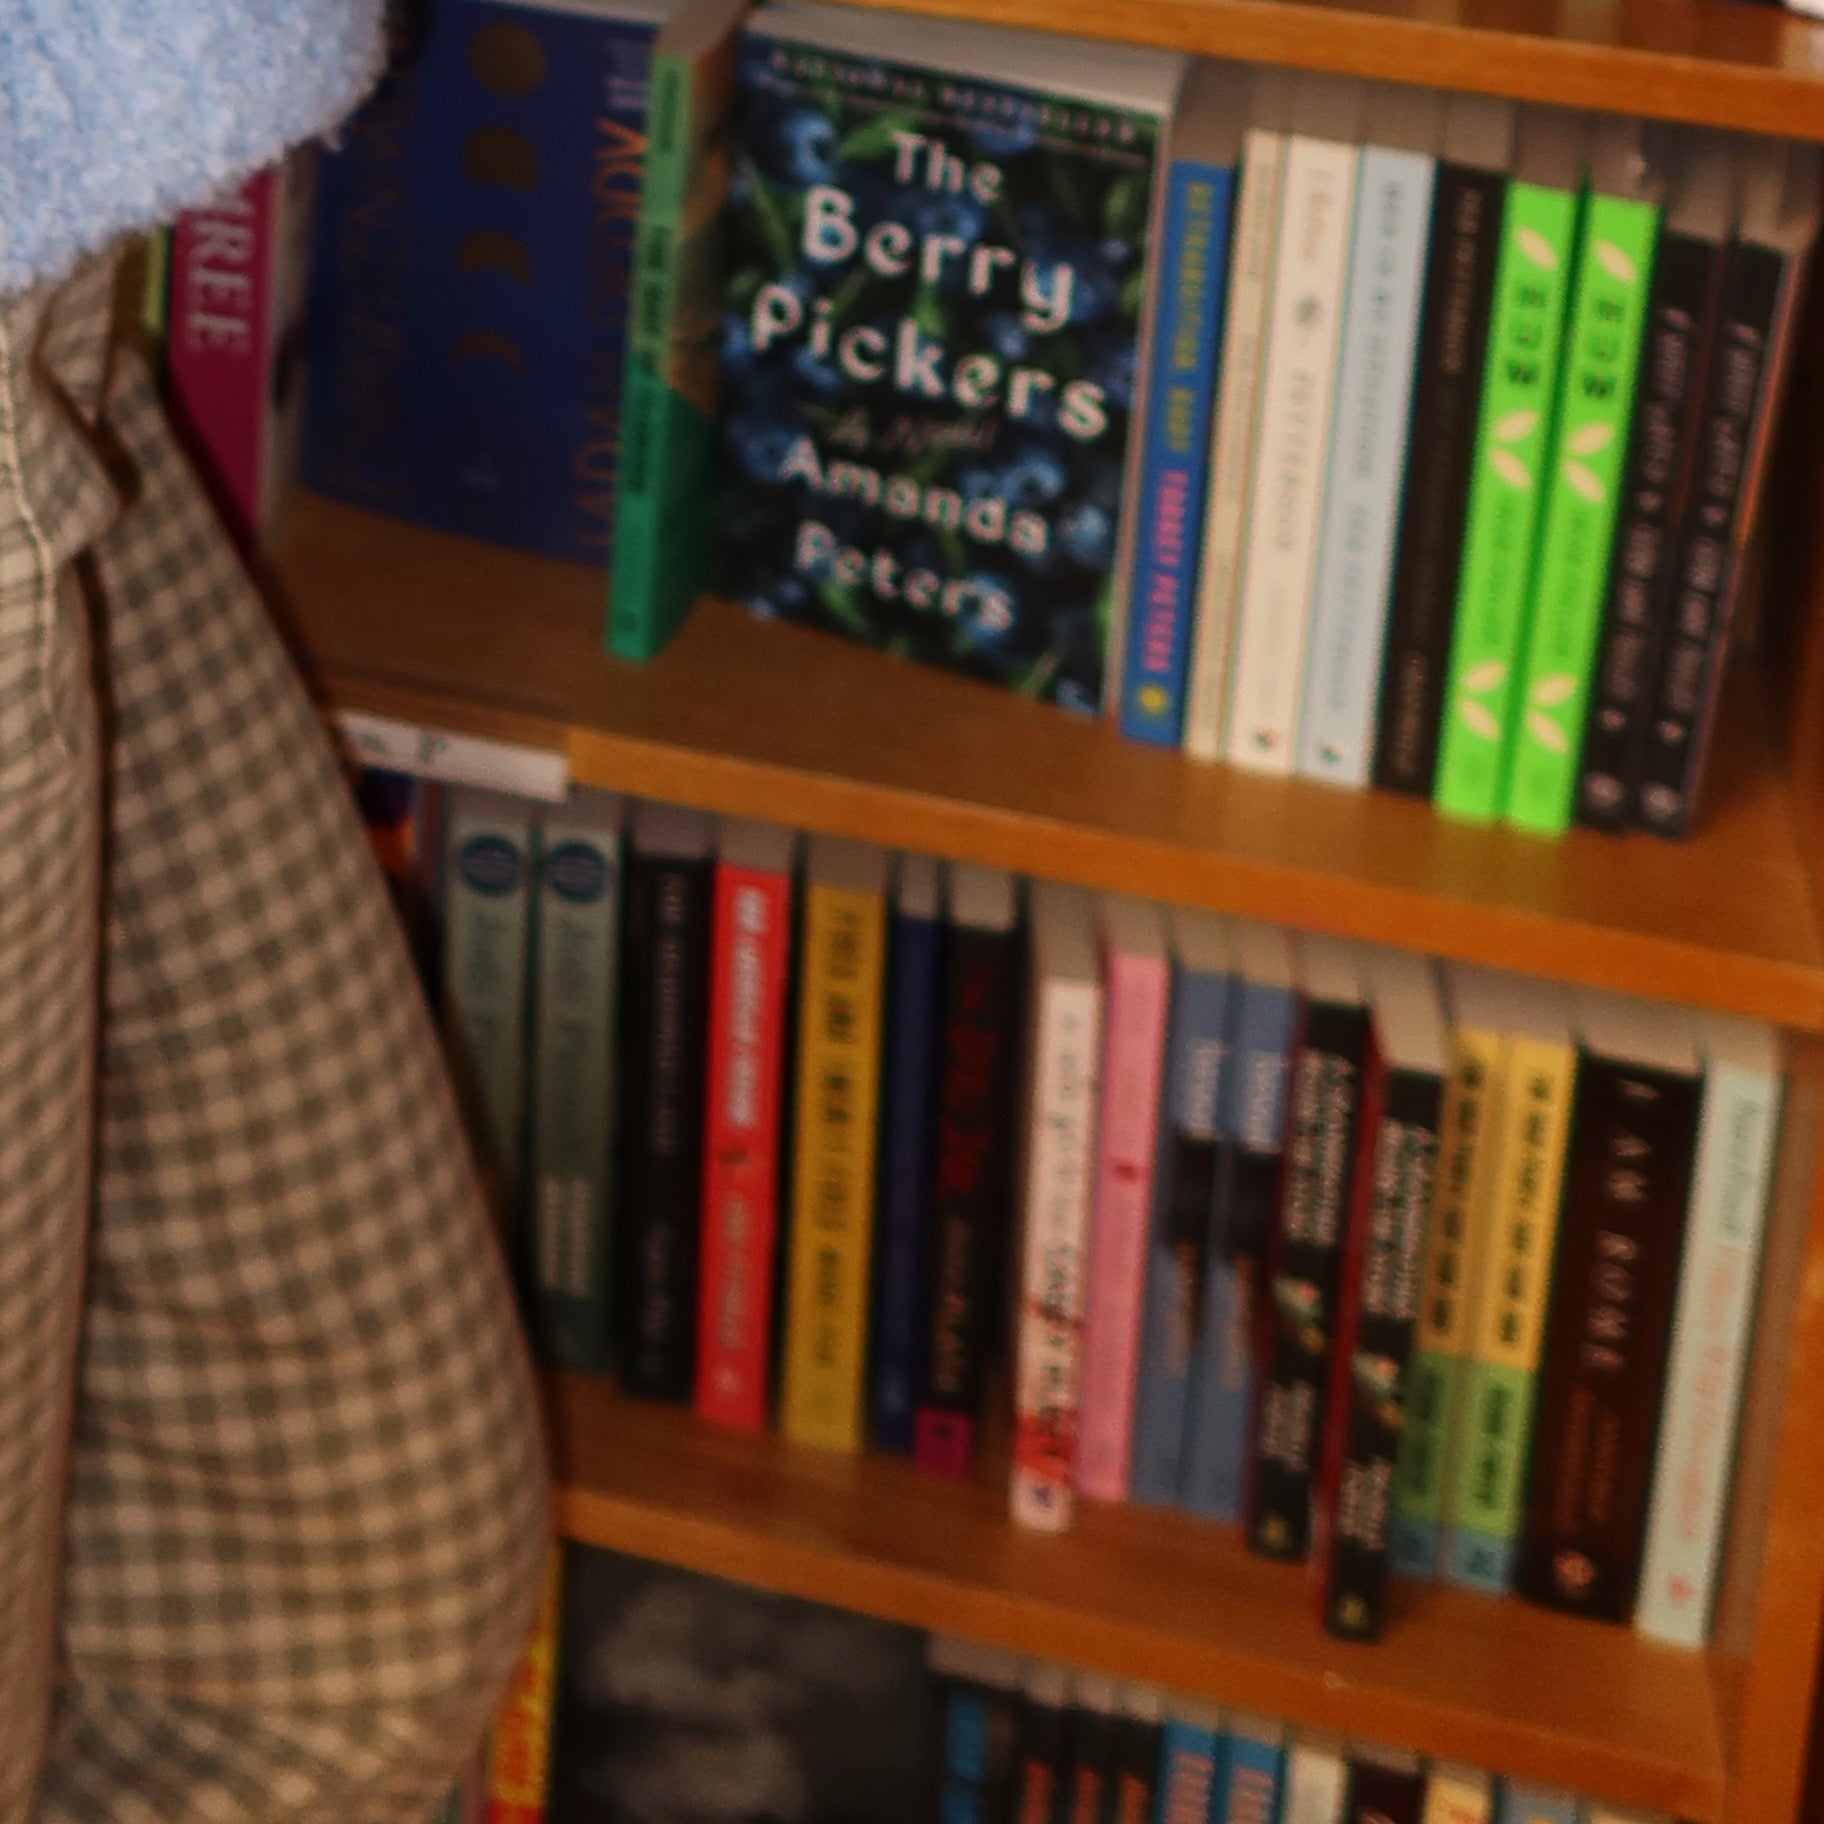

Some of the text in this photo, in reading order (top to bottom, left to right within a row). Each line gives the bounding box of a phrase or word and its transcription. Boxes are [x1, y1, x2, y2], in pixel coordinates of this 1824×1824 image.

[889, 129, 1002, 204] The
[800, 182, 1075, 334] Berry
[750, 279, 1108, 441] Pickers
[783, 437, 1050, 556] Amanda
[794, 518, 1015, 633] Peters
